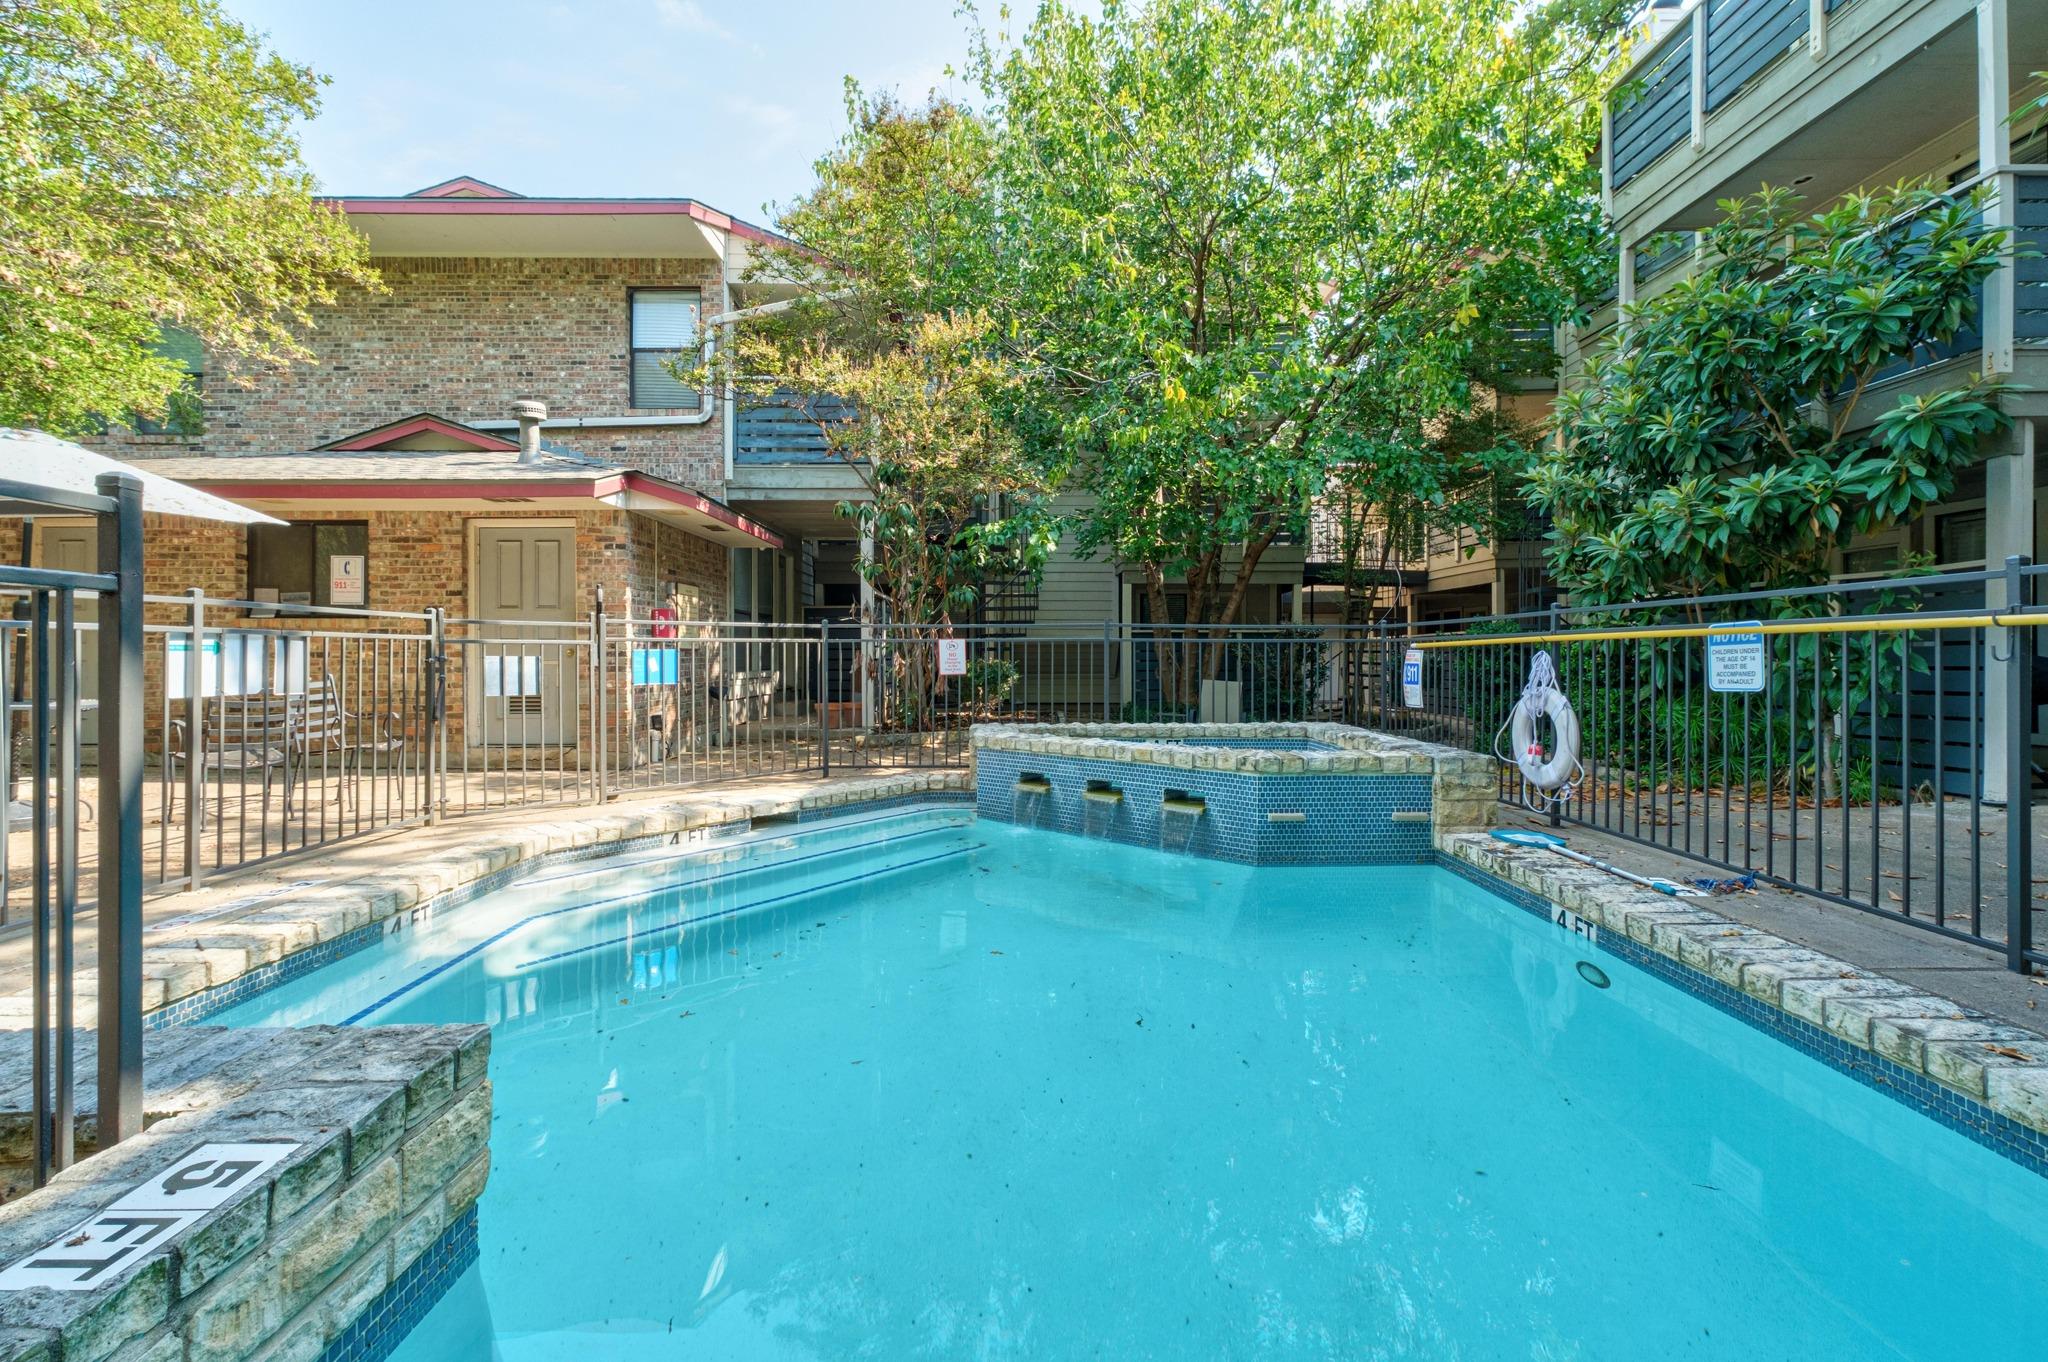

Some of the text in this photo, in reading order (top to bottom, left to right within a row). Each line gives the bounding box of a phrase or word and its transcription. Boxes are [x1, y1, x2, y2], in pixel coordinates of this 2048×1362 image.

[335, 581, 347, 589] 911
[1713, 633, 1757, 642] NOTICE
[1406, 665, 1418, 682] 911
[669, 829, 706, 845] 4 FT
[390, 904, 430, 935] 4 FT
[1556, 909, 1594, 942] 4 FT
[23, 1160, 263, 1282] 5 FT
